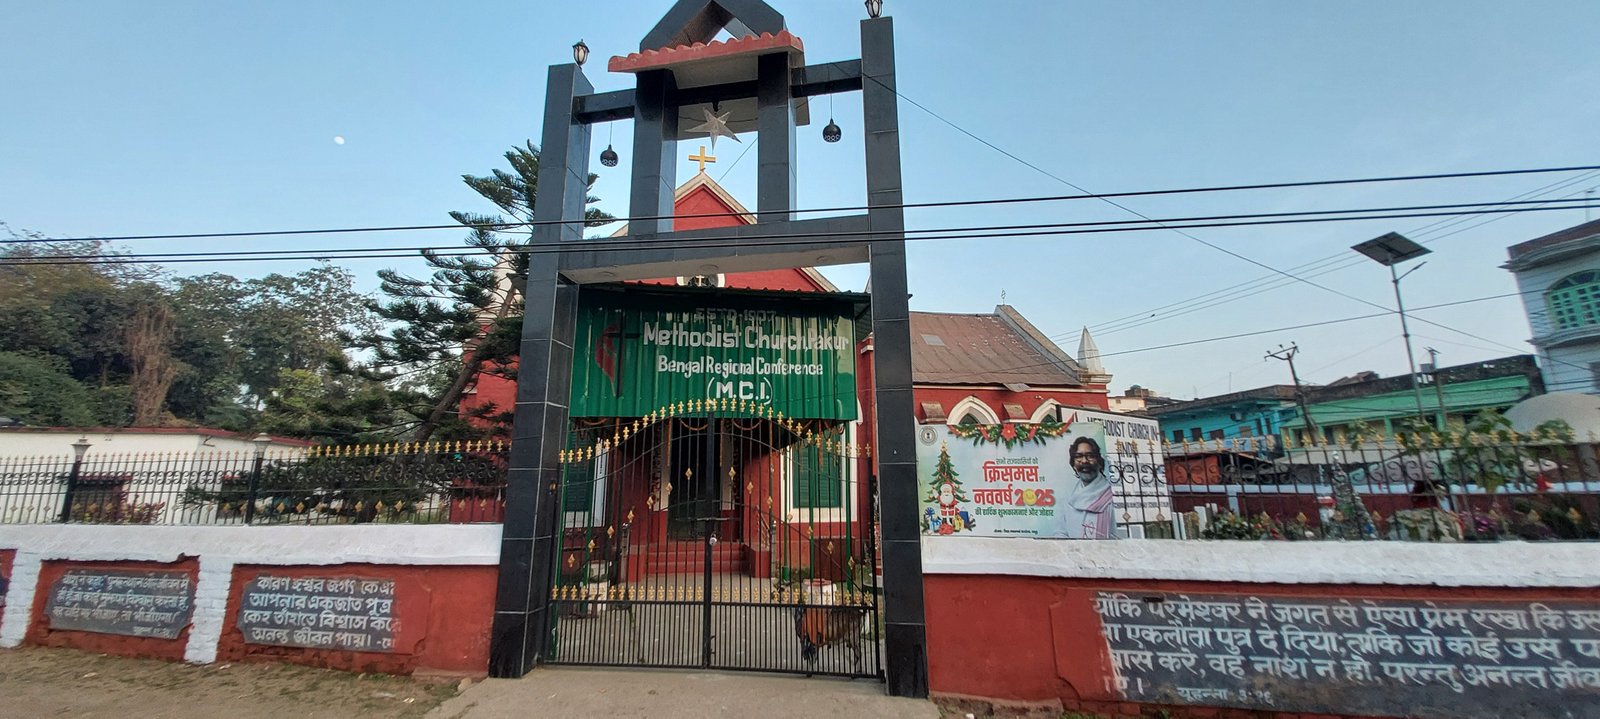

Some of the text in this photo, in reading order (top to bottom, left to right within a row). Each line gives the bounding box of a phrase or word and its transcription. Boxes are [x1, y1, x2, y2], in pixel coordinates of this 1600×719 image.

[643, 321, 742, 348] Methodist
[658, 354, 823, 378] Bengal Regional Conference
[706, 376, 773, 406] (M.C.I.)
[1127, 421, 1149, 440] CHURCH
[983, 461, 1039, 482] क्रिसमस
[972, 484, 1056, 507] नववर्ष 2025
[257, 576, 289, 591] কারণ
[327, 579, 355, 594] জগৎ
[249, 593, 306, 609] আপনার
[307, 596, 362, 612] একজাত
[319, 610, 368, 630] বিশ্বাস
[1146, 594, 1247, 624] परमेश्वर
[1245, 596, 1269, 621] ने
[1271, 603, 1332, 627] जगत
[1331, 598, 1360, 628] से
[1361, 598, 1419, 631] ऐसा
[1419, 600, 1469, 629] प्रेम
[1530, 602, 1565, 638] कि
[251, 627, 289, 643] অনন্ত
[293, 627, 334, 645] জীবন
[1213, 627, 1256, 655] पुत्र
[1255, 622, 1280, 655] दे
[1402, 622, 1444, 658] जो
[1443, 628, 1502, 664] कोई
[1503, 636, 1563, 661] उस
[1204, 653, 1247, 680] वह
[1248, 654, 1309, 680] नाश
[1311, 658, 1338, 681] न
[1379, 661, 1464, 694] परन्तु
[1460, 663, 1549, 689] अनन्त
